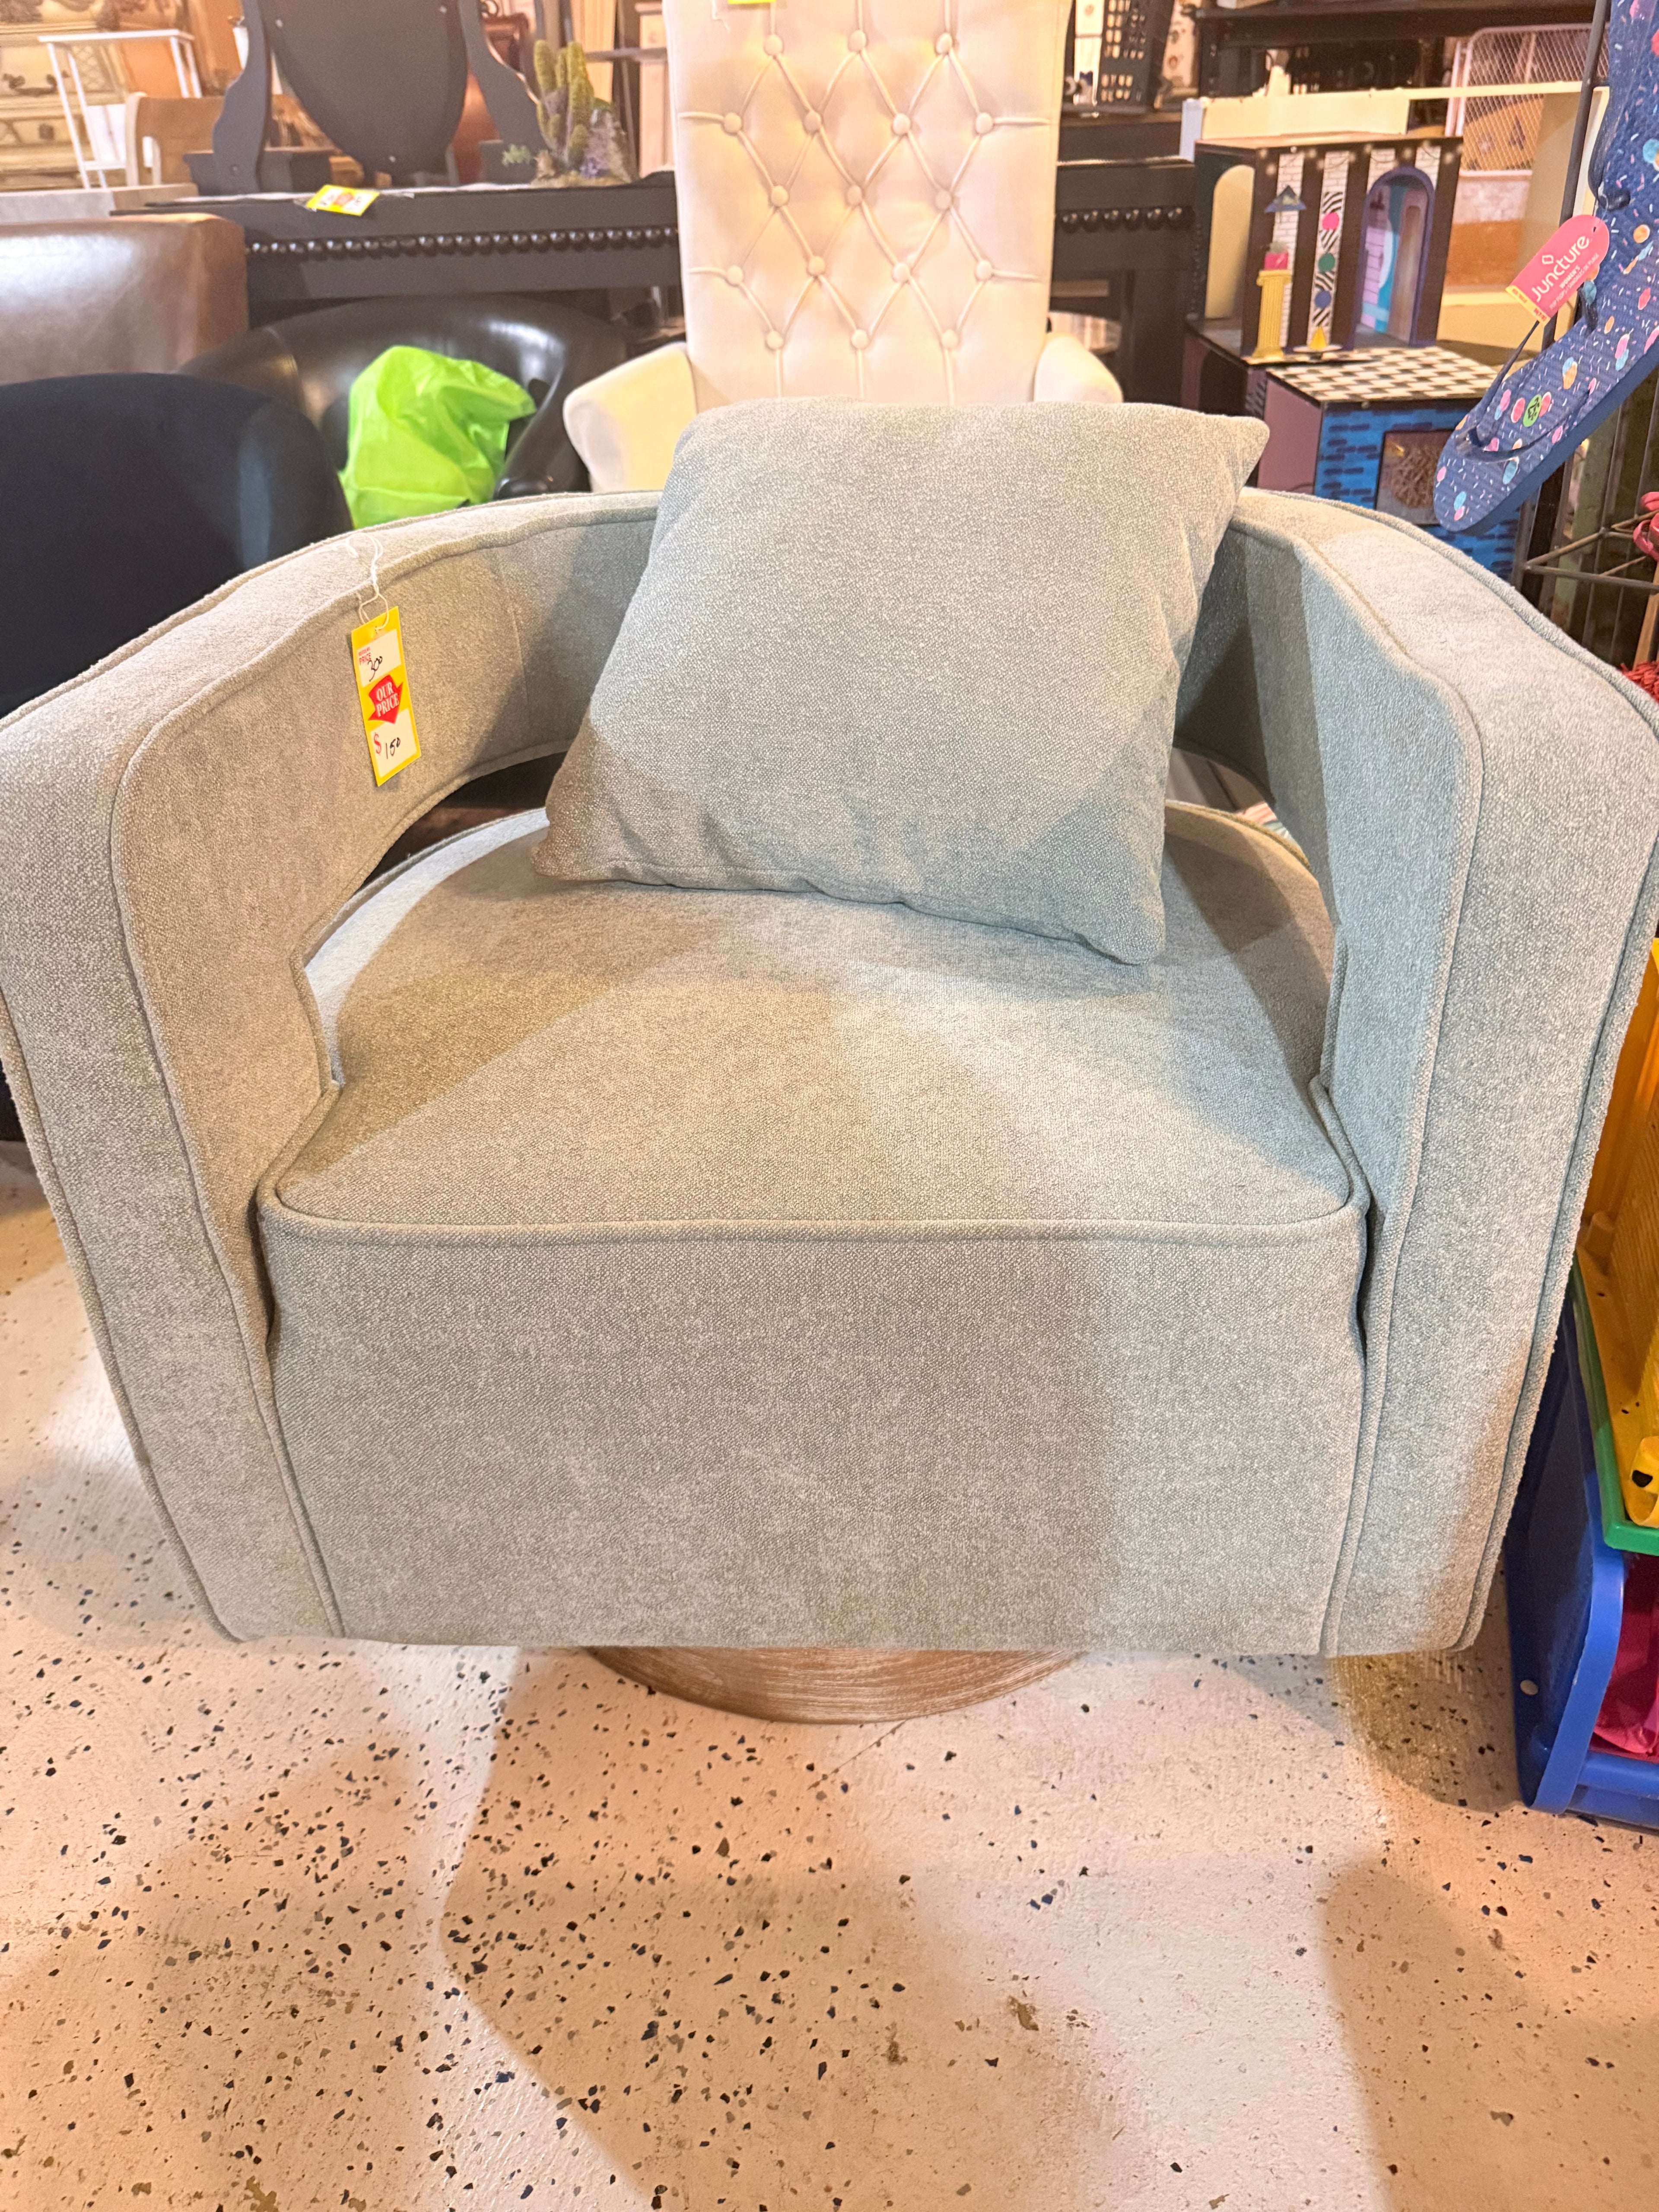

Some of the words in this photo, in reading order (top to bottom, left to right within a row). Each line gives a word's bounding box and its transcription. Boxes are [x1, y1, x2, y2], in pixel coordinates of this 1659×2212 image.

[1532, 236, 1589, 302] Juncture
[1559, 265, 1581, 289] WOMEN'S
[359, 652, 371, 665] PRICE
[367, 656, 383, 682] 300
[377, 682, 394, 702] OUR
[376, 693, 400, 717] PRICE
